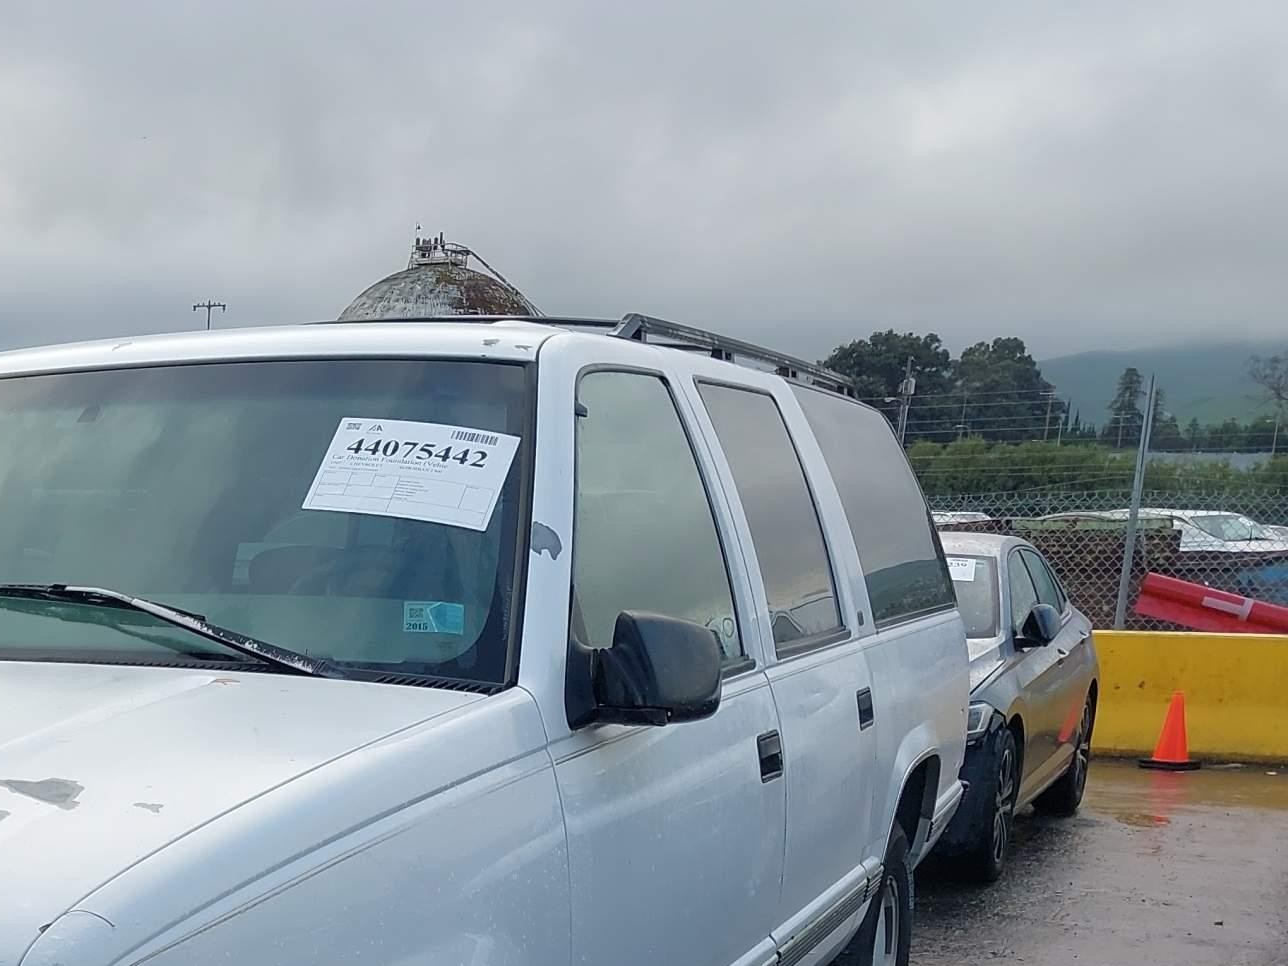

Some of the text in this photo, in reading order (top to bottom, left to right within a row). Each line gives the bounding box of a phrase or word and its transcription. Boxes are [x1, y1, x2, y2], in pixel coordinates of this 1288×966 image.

[346, 438, 488, 468] 44075442
[346, 455, 380, 463] Donation
[381, 457, 422, 466] Foundation
